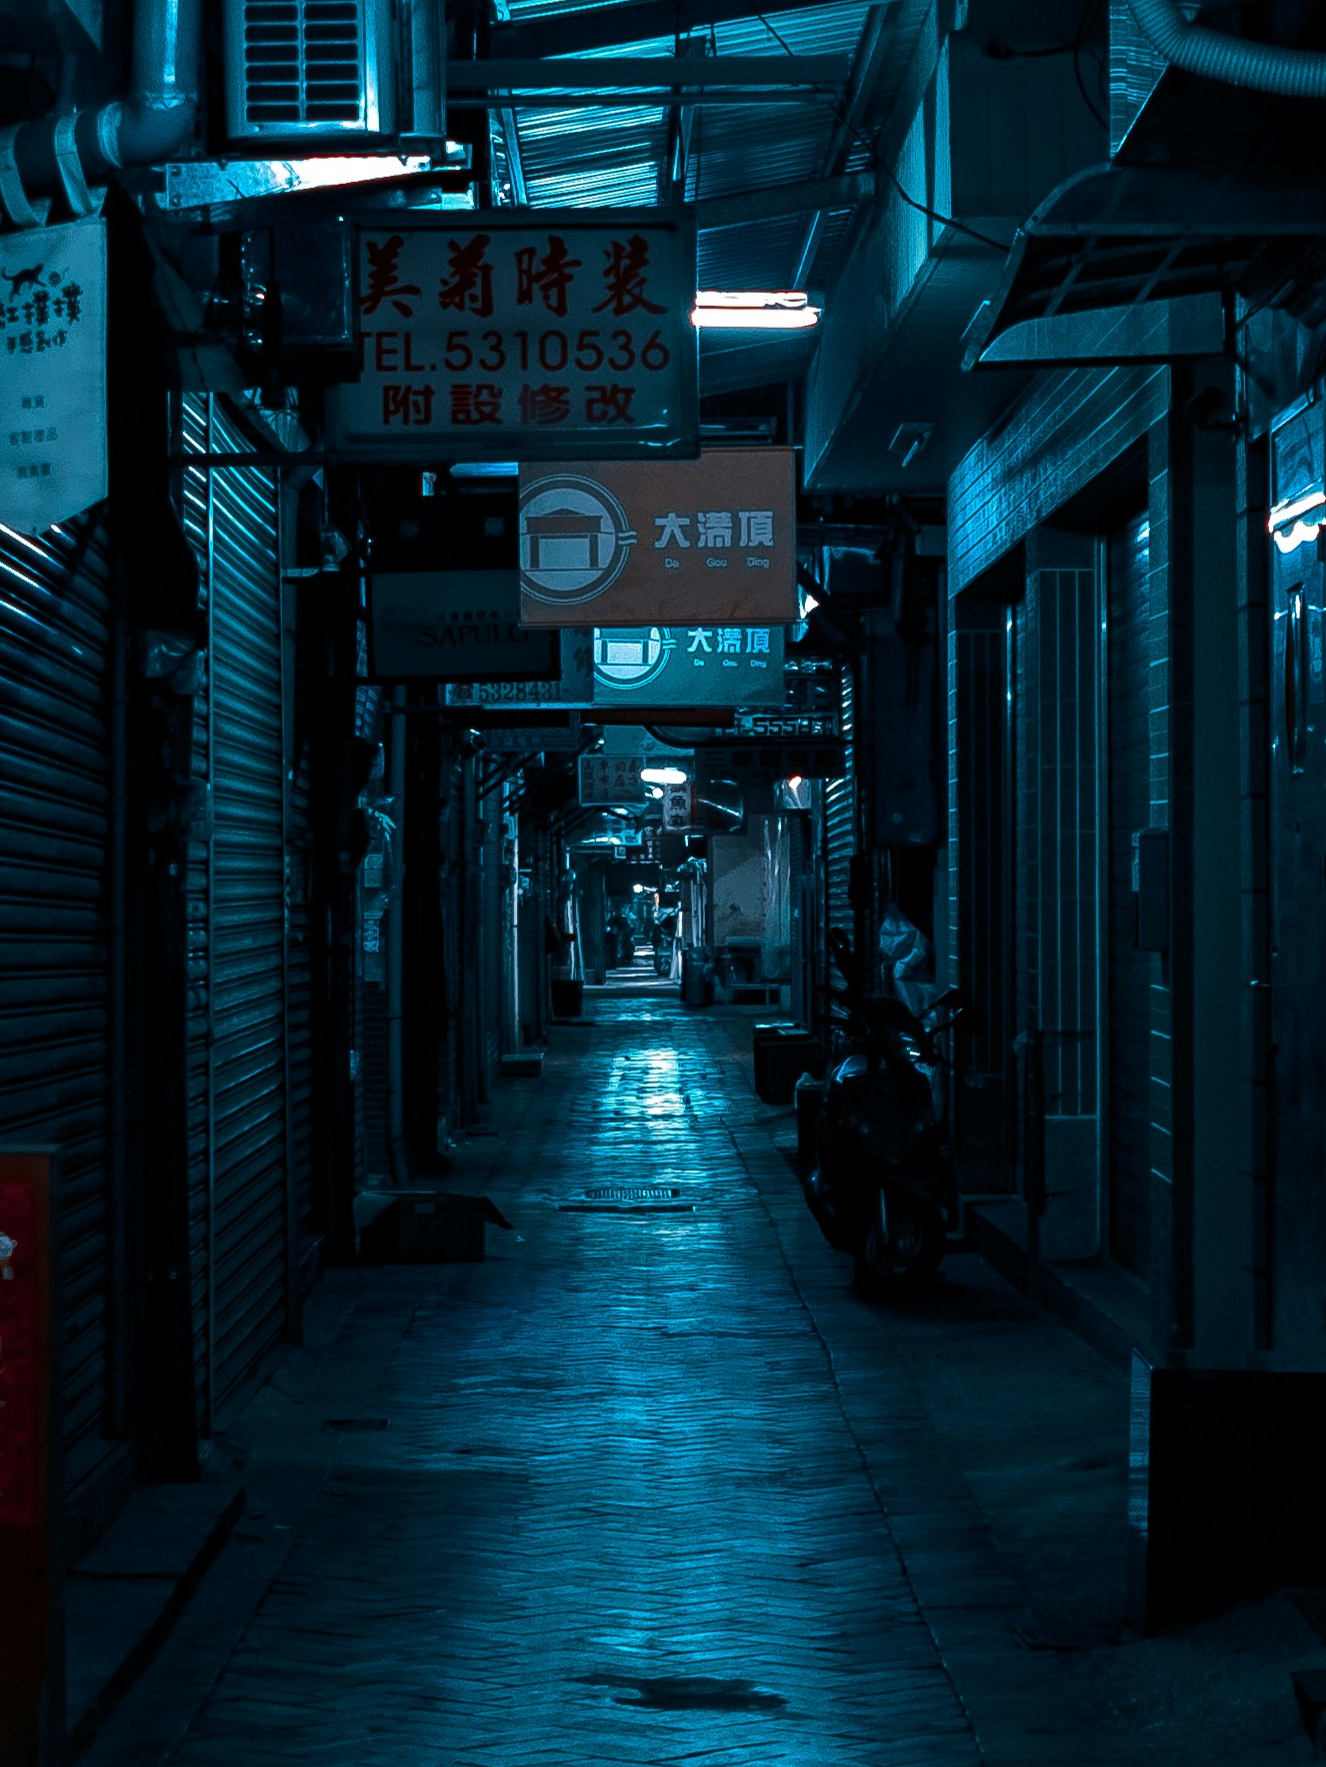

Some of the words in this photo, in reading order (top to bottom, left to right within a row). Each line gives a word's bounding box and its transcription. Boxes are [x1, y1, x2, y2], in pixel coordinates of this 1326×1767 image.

[357, 234, 670, 317] 美菊時裝
[382, 385, 636, 425] 附設修改
[665, 558, 680, 568] Da
[707, 557, 728, 568] Gou
[747, 556, 771, 570] Ding
